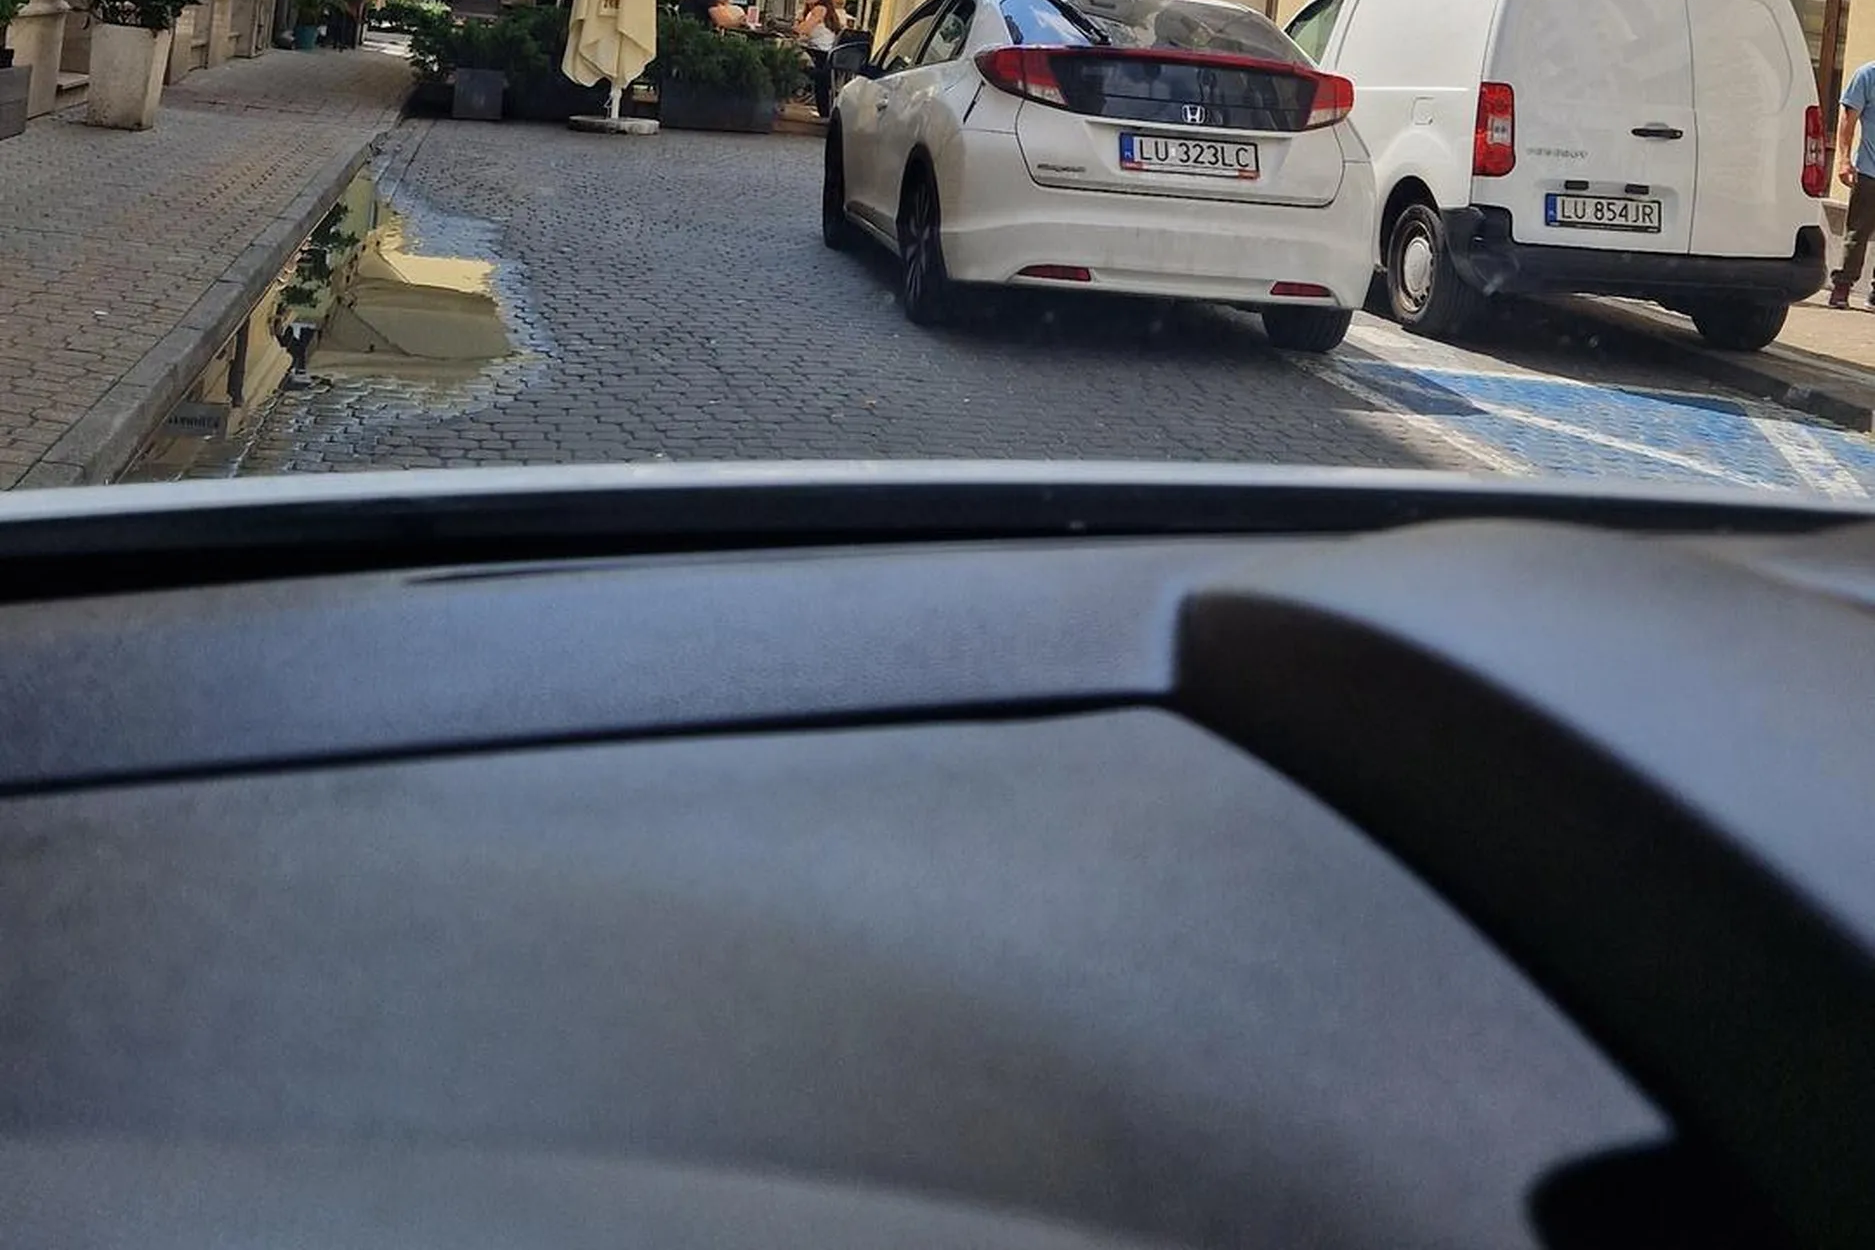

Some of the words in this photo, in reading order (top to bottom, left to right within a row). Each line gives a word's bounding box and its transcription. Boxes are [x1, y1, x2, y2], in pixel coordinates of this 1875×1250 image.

[1139, 138, 1169, 162] LU
[1178, 142, 1249, 168] 323LC
[1561, 199, 1586, 220] LU
[1593, 201, 1654, 224] 854JR
